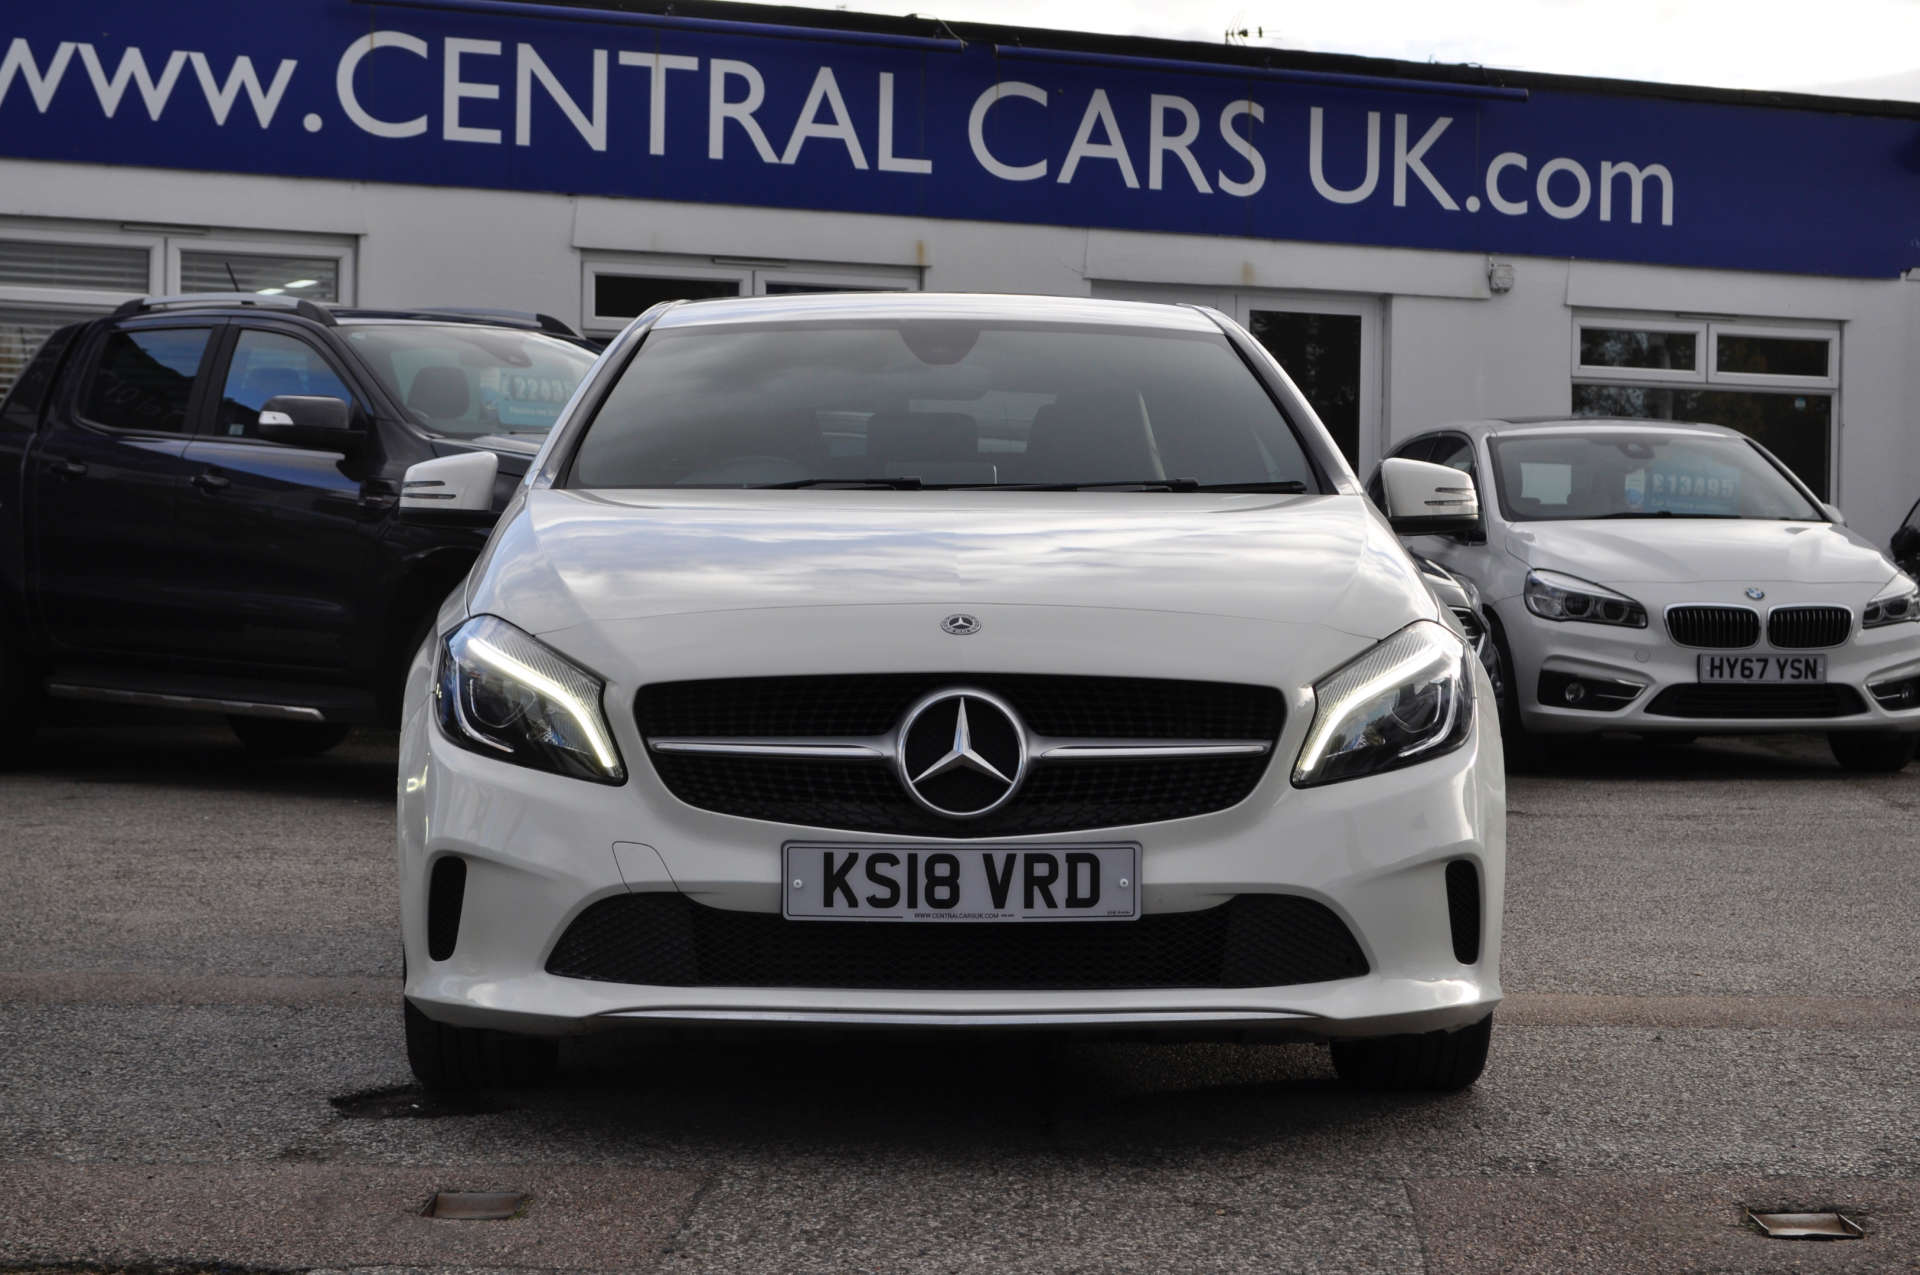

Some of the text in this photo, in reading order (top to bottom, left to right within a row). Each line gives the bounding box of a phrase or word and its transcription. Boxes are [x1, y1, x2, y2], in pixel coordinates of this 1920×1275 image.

[968, 82, 1266, 197] CARS
[1309, 107, 1674, 226] UK.com
[1709, 656, 1818, 680] HY67 YSN
[822, 851, 1101, 910] KS18 VRD
